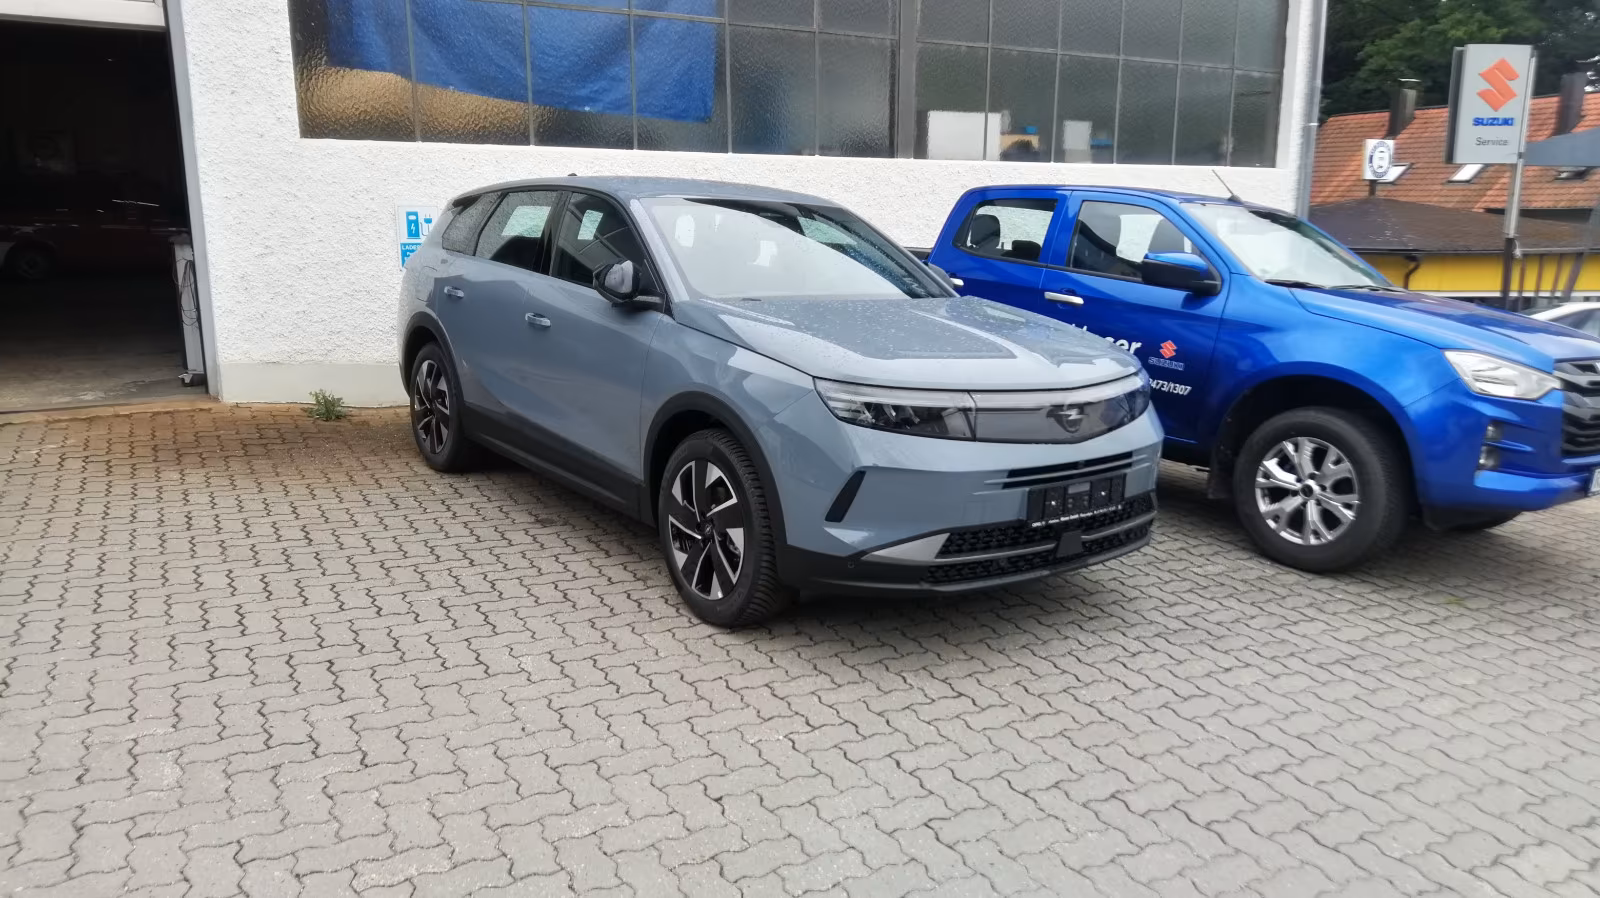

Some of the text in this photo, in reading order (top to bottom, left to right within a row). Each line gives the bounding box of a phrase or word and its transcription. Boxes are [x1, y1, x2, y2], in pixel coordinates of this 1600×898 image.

[1472, 117, 1514, 126] SUZUKI
[1475, 136, 1509, 146] Service
[1148, 356, 1185, 371] SUZUKI
